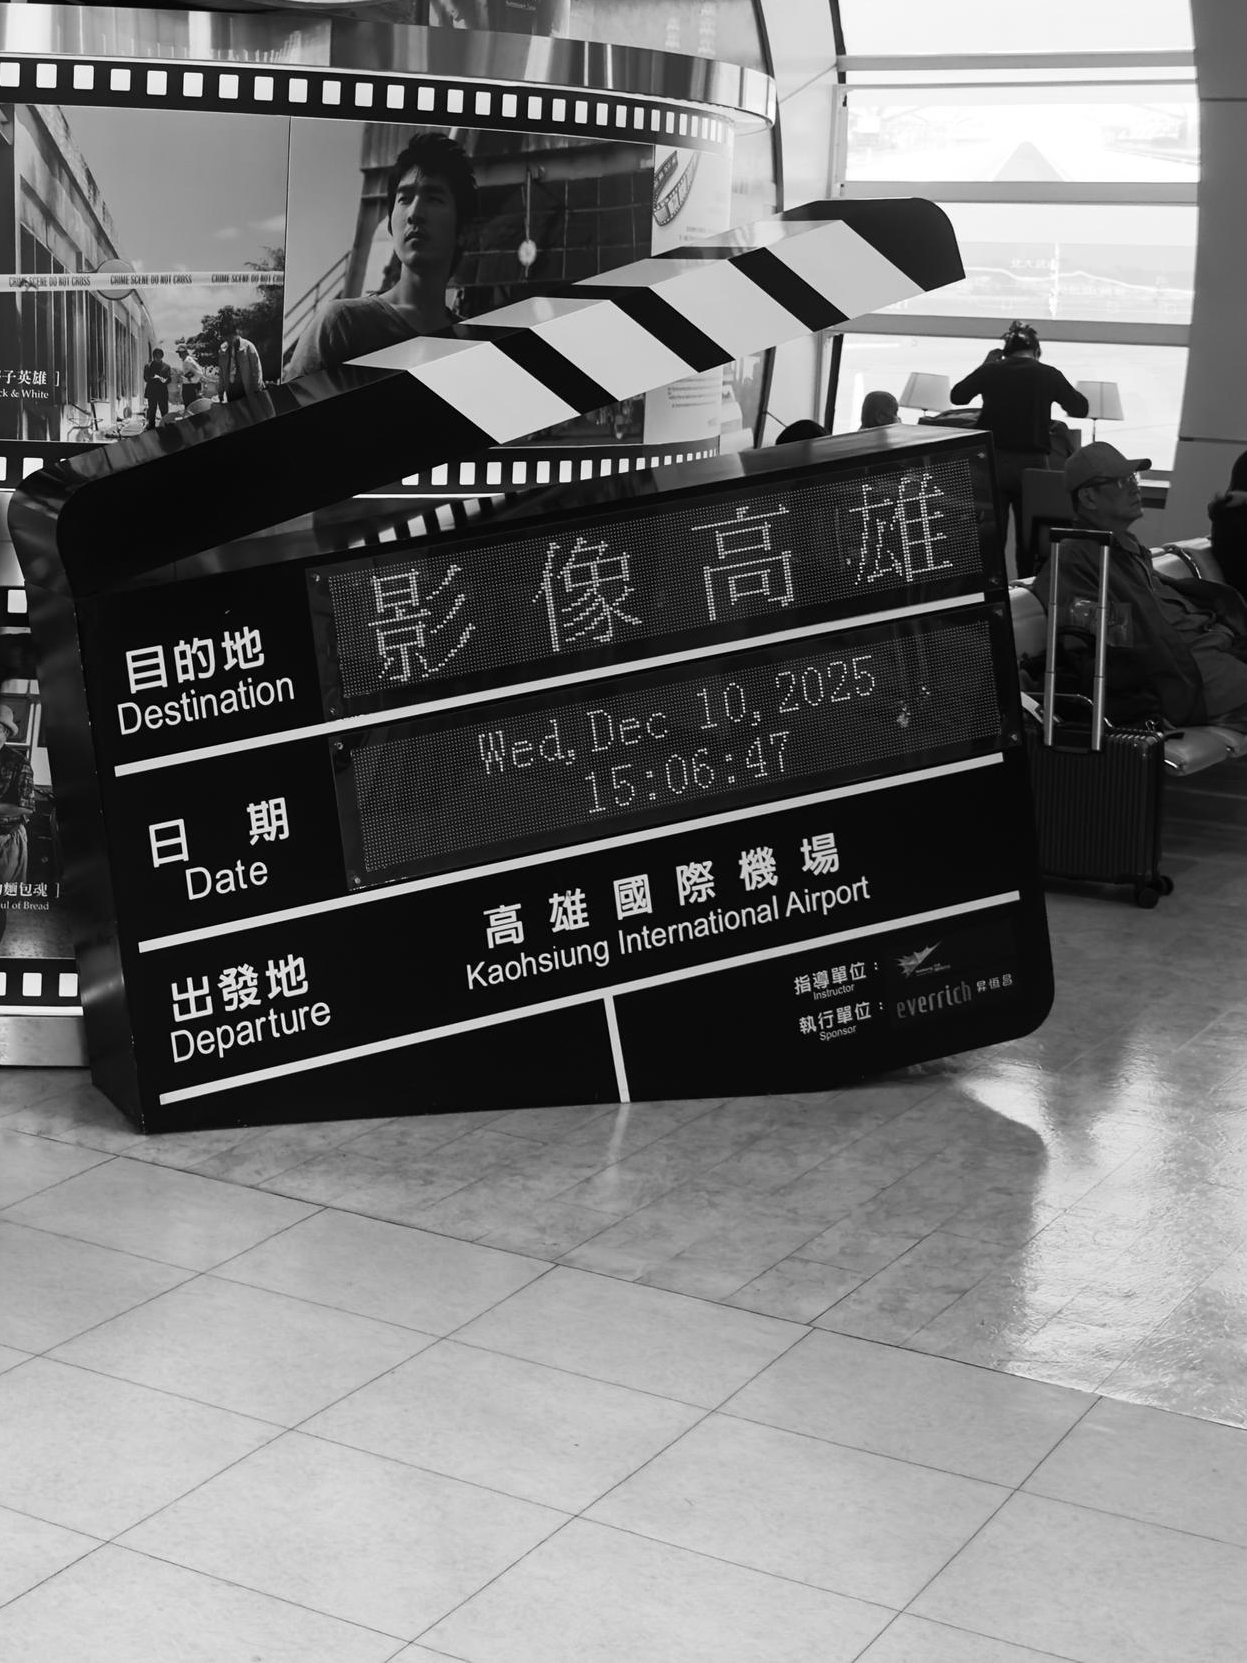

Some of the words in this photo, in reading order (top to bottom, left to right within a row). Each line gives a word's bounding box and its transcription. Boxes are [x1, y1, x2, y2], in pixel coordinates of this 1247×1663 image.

[49, 276, 58, 287] DO
[58, 276, 70, 287] NOT
[72, 275, 91, 287] CROSS
[110, 275, 129, 285] CRIME
[131, 275, 149, 285] SCENE
[151, 275, 159, 284] DO
[160, 274, 171, 284] NOT
[173, 274, 192, 284] CROSS
[211, 273, 229, 283] CRIME
[232, 273, 249, 283] SCENE
[260, 273, 272, 283] NOT
[10, 389, 20, 398] &
[21, 389, 49, 399] White
[368, 472, 954, 684] 影像高雄
[125, 626, 266, 694] 目的地
[117, 677, 295, 735] Destination
[585, 730, 790, 813] 15:06:47
[185, 859, 269, 900] Date
[483, 832, 840, 949] 高雄國際機場
[11, 900, 21, 910] of
[23, 900, 50, 911] Bread
[466, 938, 610, 990] Kaohsiung
[618, 894, 779, 955] International
[786, 875, 871, 916] Airport
[171, 954, 309, 1023] 出發地
[813, 983, 855, 1001] Instructor
[896, 980, 972, 1019] everrich
[170, 1002, 331, 1063] Departure
[819, 1024, 857, 1042] Sponsor
